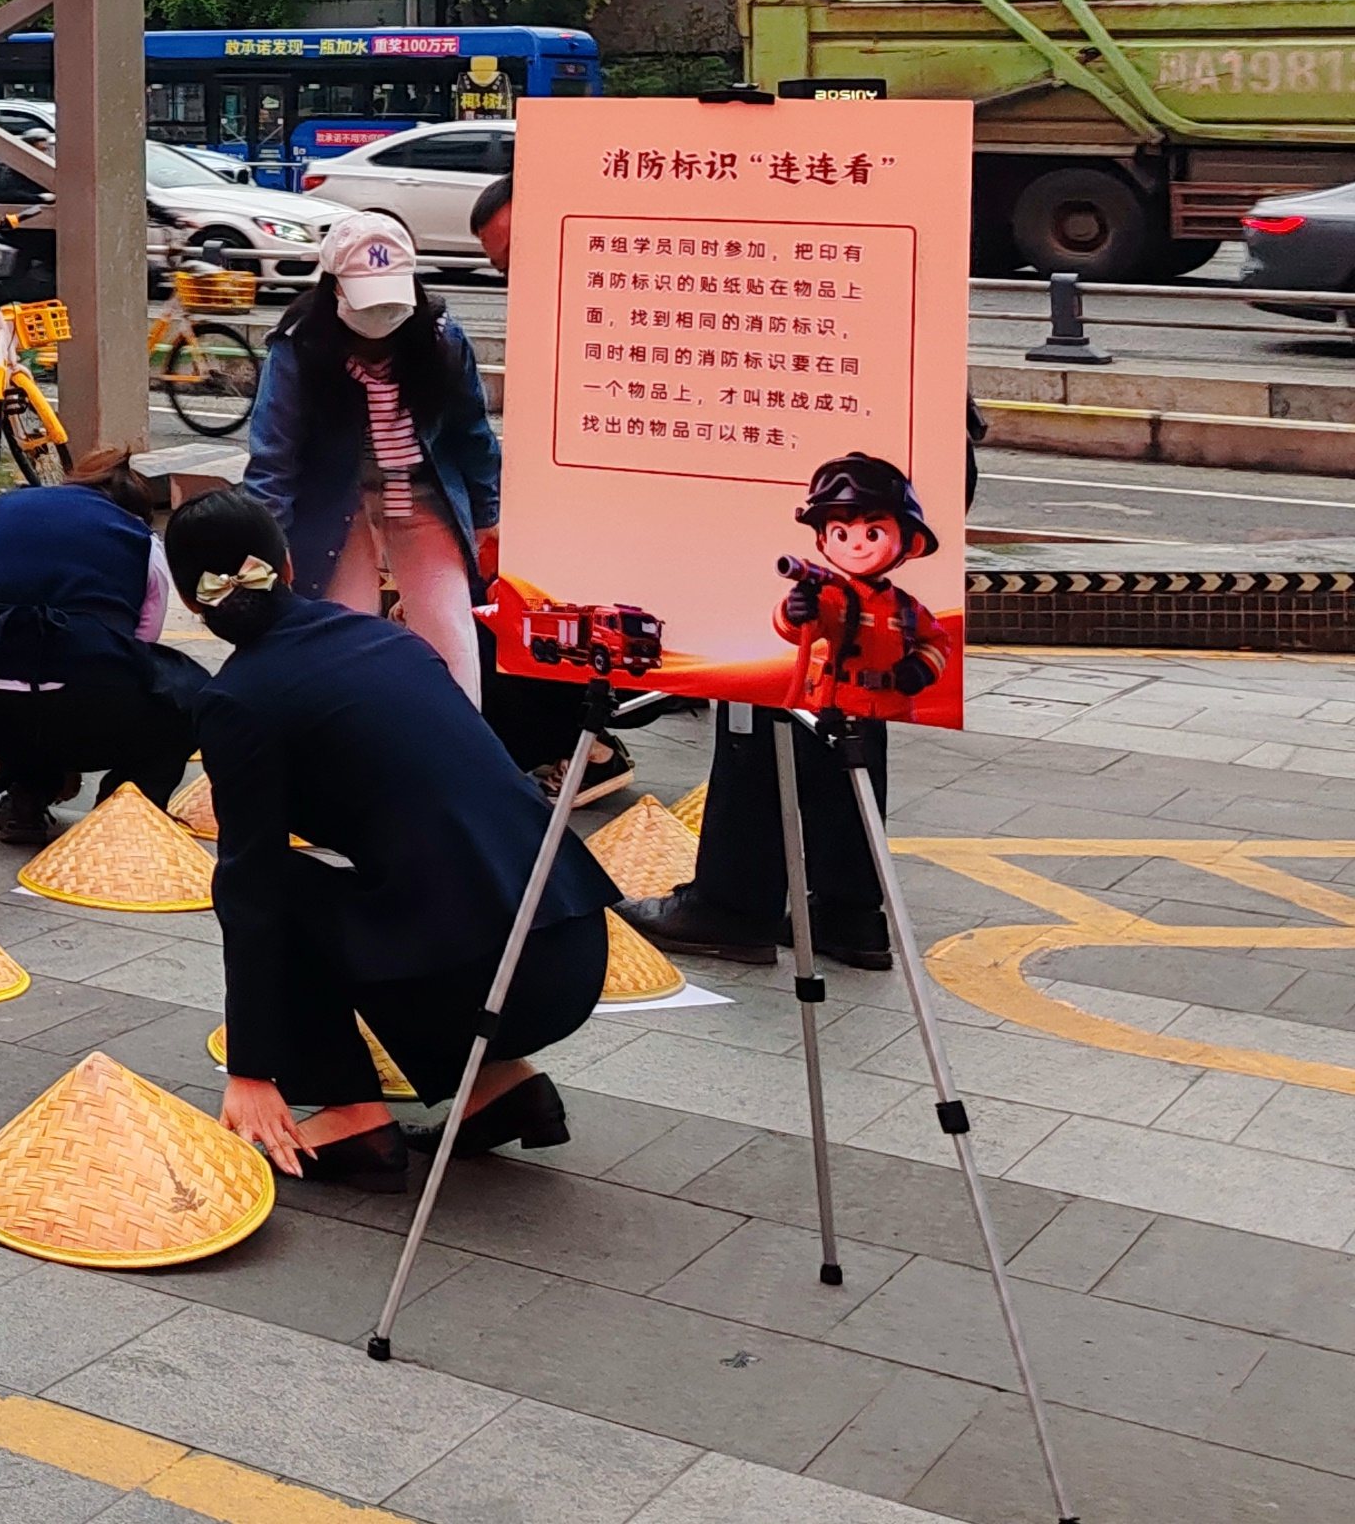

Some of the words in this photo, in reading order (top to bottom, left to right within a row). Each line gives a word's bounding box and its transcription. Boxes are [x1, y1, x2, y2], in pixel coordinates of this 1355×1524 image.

[602, 148, 896, 185] 消防标识“连连看”
[589, 235, 863, 263] 两组学员同时参加，把印有
[587, 272, 863, 300] 消防标识的贴纸贴在物品上
[584, 343, 859, 375] 同时相同的消防标识要在同
